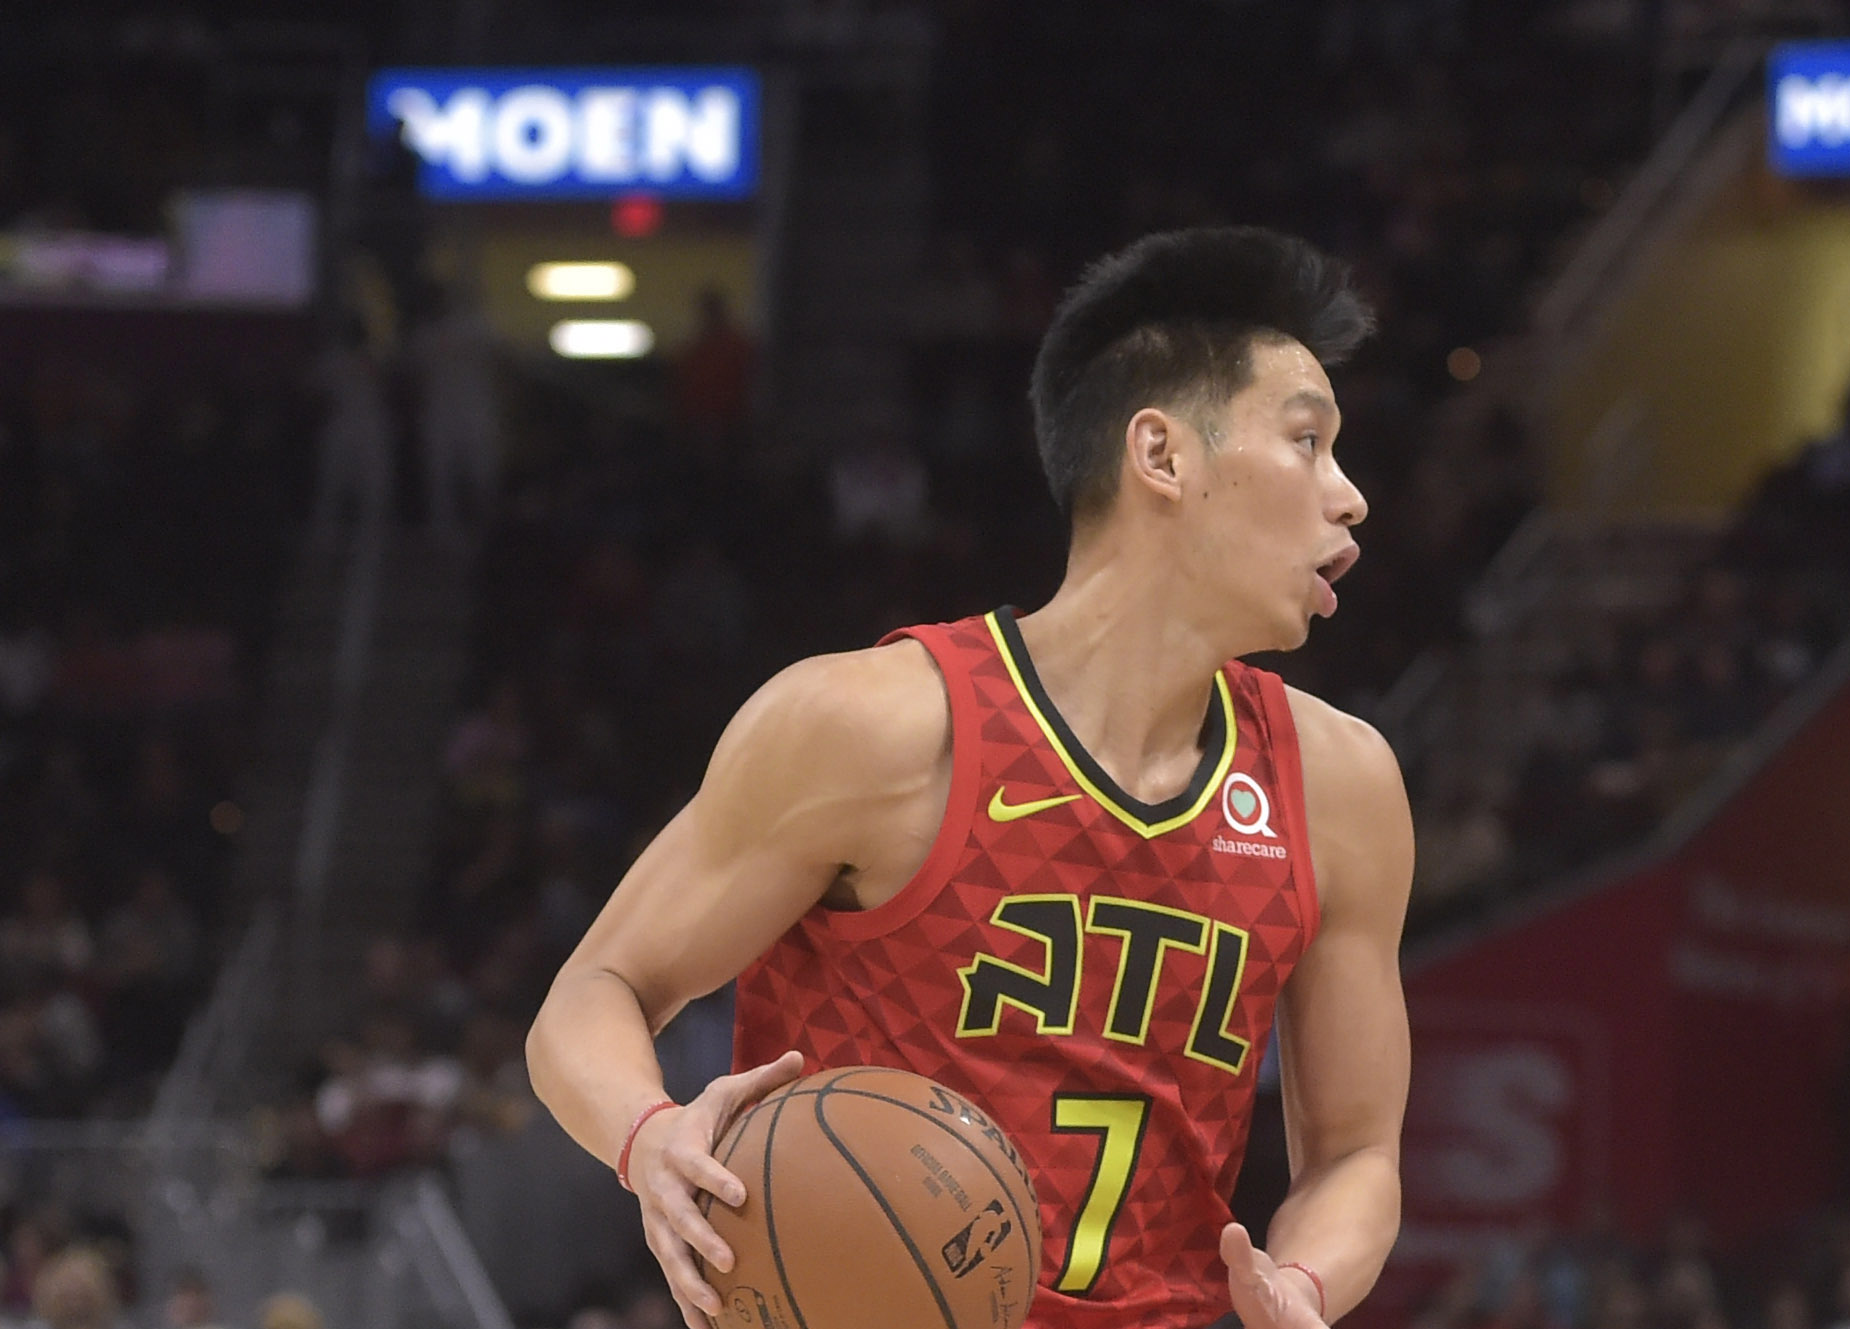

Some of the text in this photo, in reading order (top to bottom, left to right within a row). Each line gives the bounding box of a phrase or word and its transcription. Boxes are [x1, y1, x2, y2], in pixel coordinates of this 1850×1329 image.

[387, 84, 741, 184] MOEN
[1212, 834, 1288, 859] sharecare
[954, 893, 1252, 1076] ATL
[1050, 1091, 1152, 1298] 7
